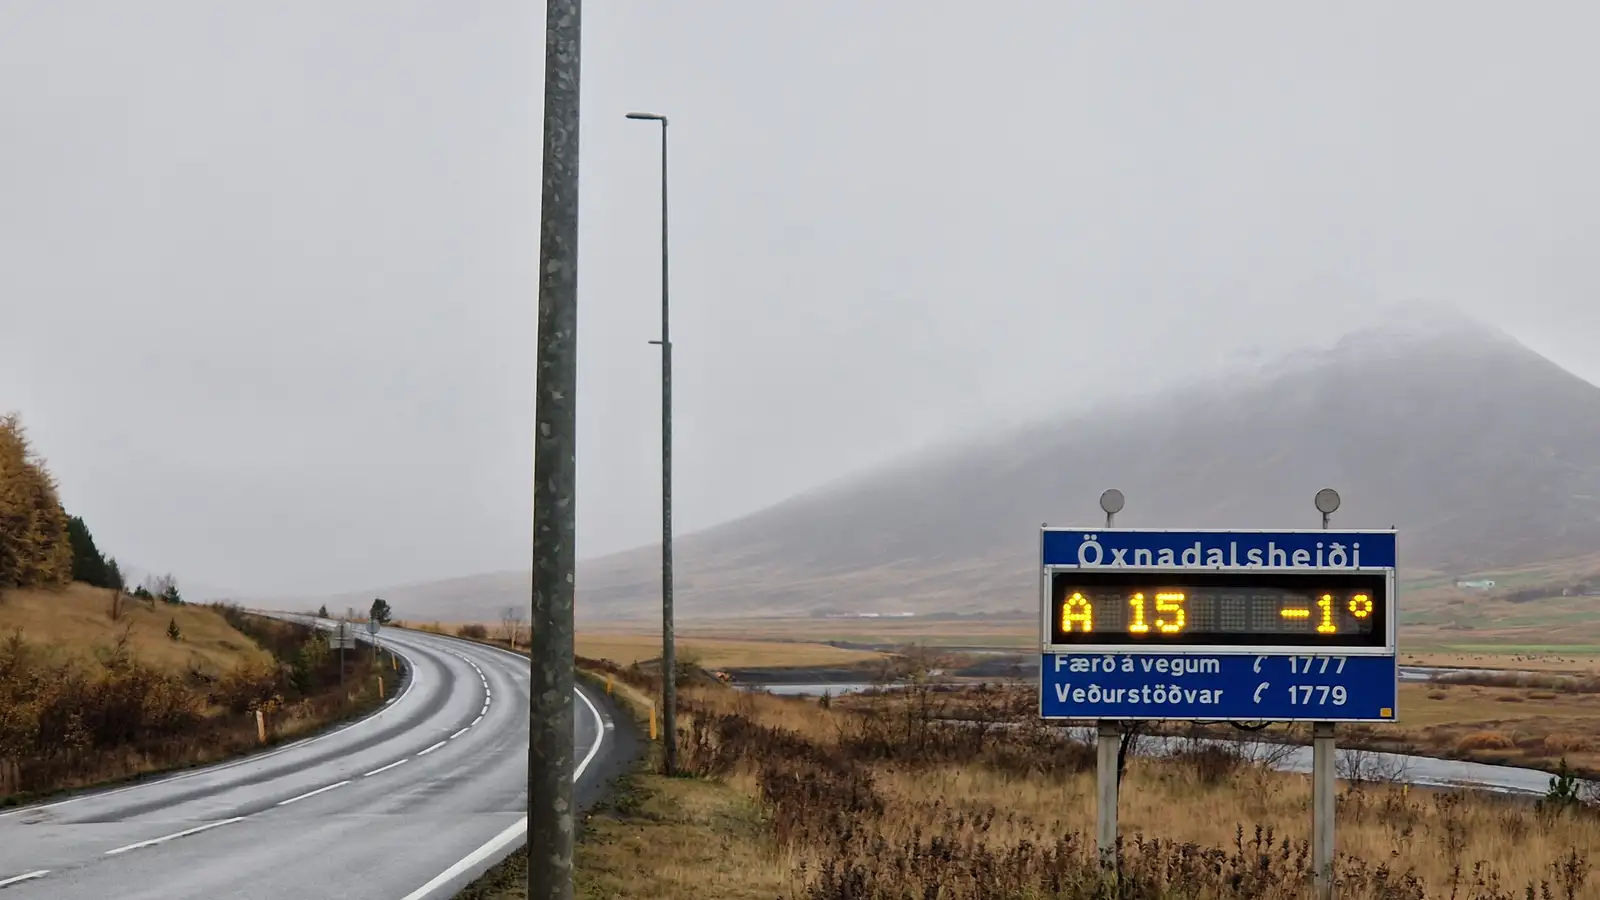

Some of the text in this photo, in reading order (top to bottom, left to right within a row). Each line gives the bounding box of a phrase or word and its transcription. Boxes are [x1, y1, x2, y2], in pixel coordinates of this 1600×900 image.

[1078, 534, 1361, 567] Öxnadalsheiði
[1062, 592, 1093, 633] A
[1129, 592, 1186, 633] 15
[1054, 655, 1348, 677] Færð á vegum 1777
[1054, 683, 1348, 706] Veðurstöðvar 1779
